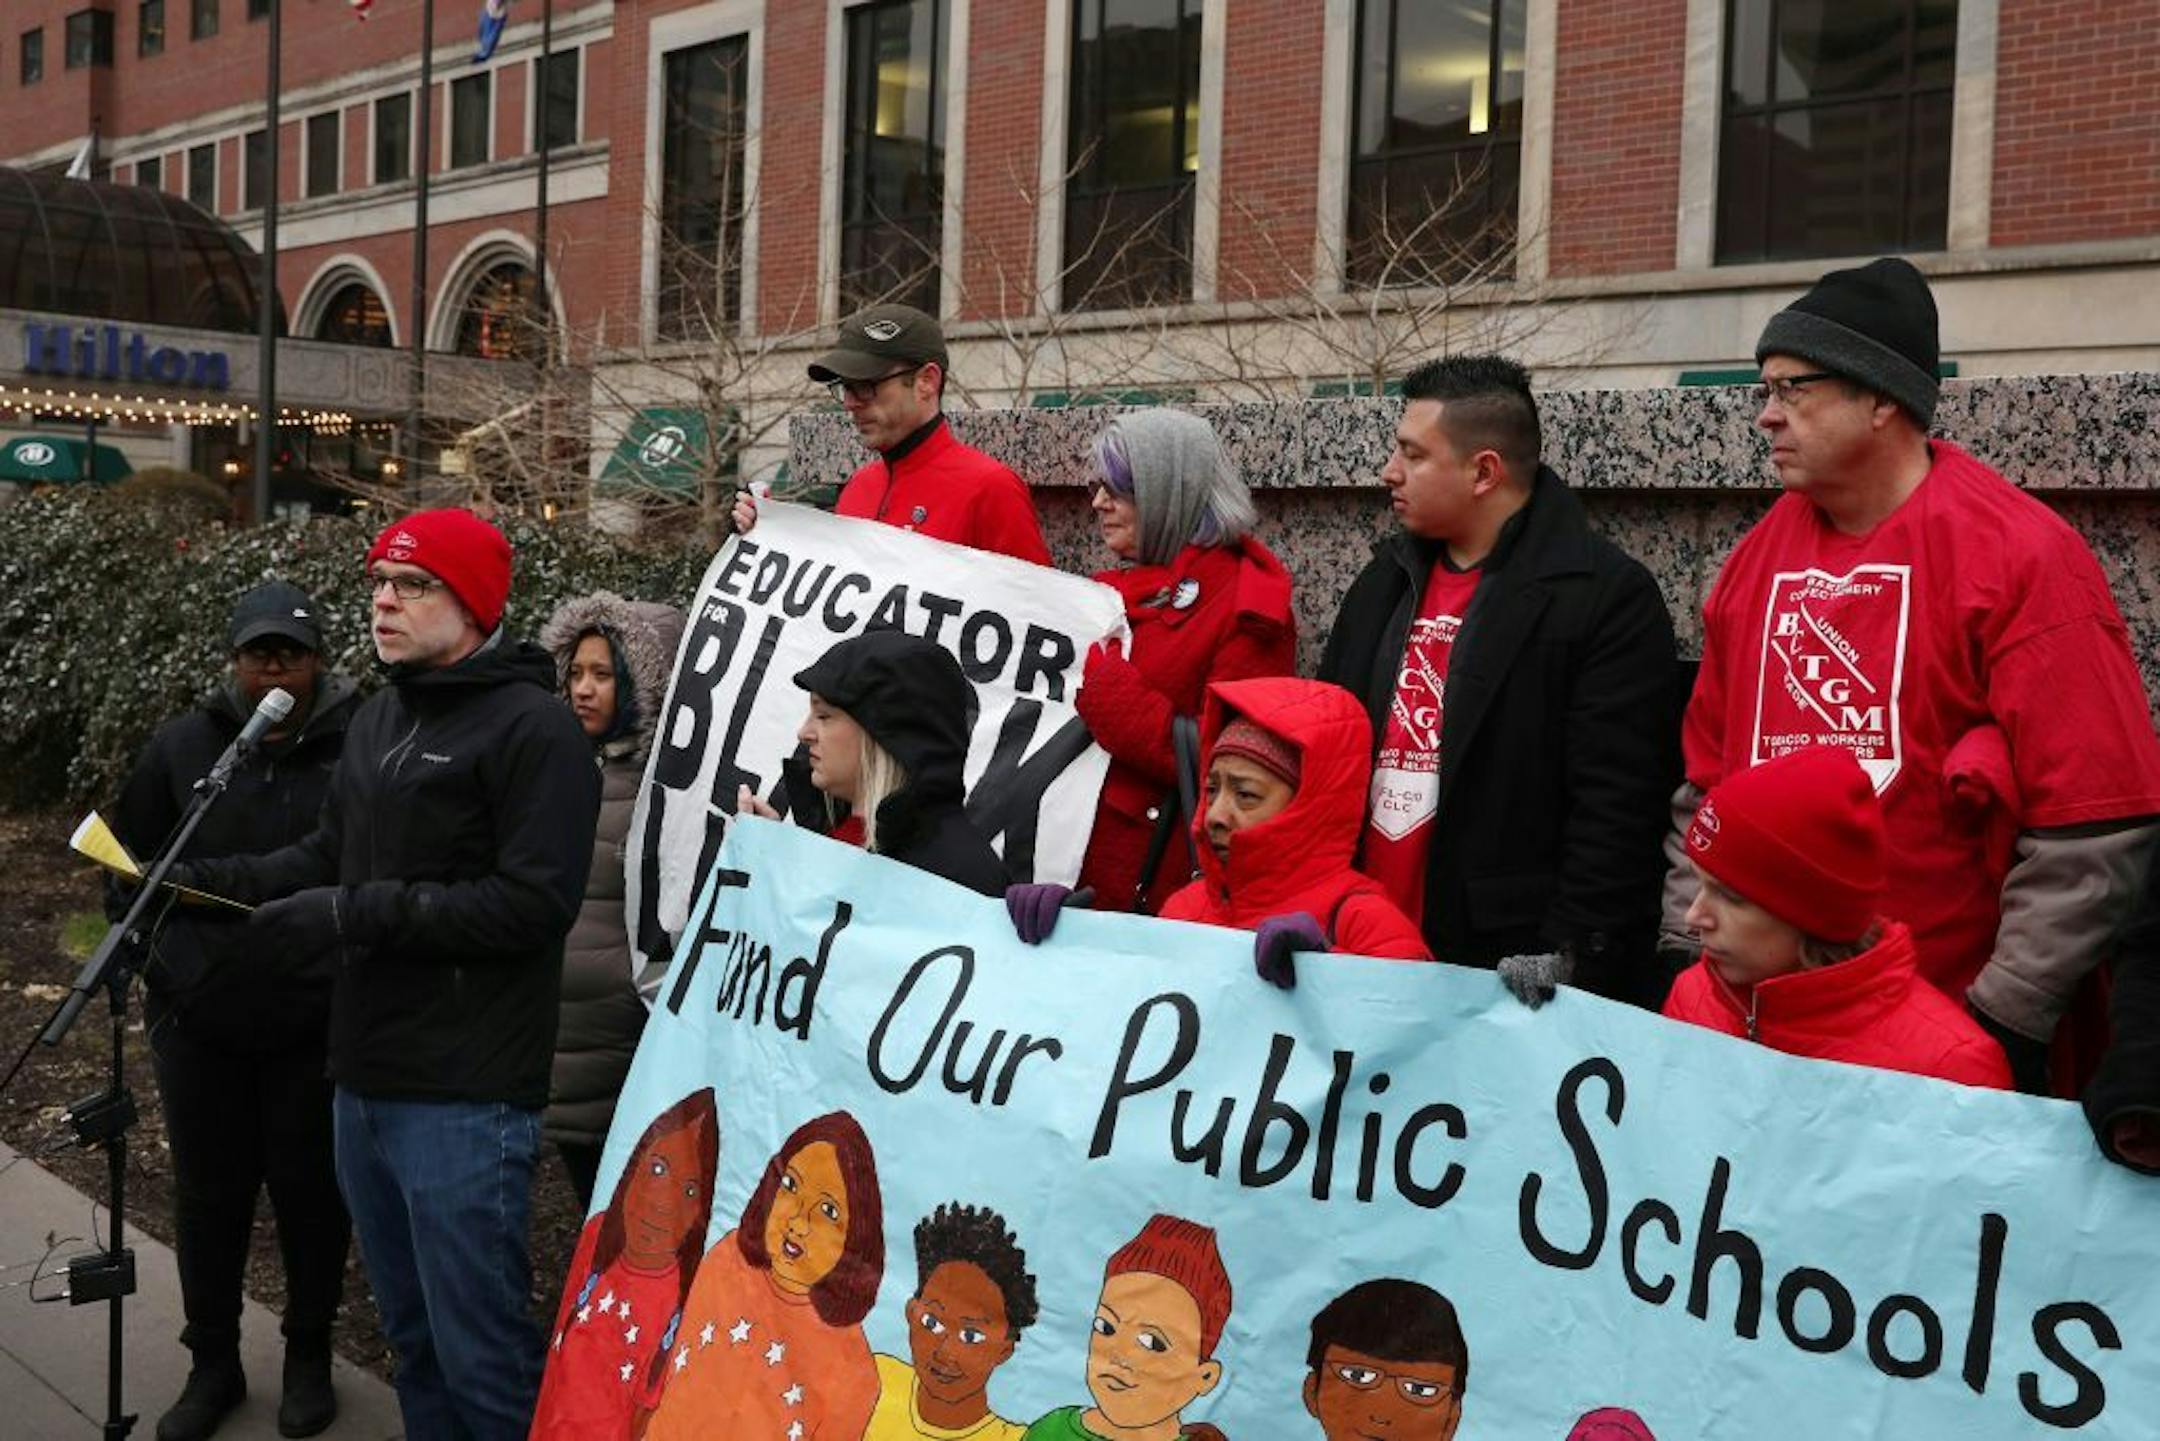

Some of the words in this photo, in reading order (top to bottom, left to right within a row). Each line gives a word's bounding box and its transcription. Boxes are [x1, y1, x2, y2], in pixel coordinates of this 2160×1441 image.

[25, 321, 230, 390] Hilton
[702, 603, 729, 624] FOR
[714, 540, 1076, 703] EDUCATOR
[1816, 616, 1860, 664] UNION
[655, 596, 1096, 884] BLK
[666, 867, 853, 1040] Fund
[866, 945, 1064, 1106] Our
[1088, 991, 1467, 1209] Public
[1518, 1057, 2123, 1429] Schools
